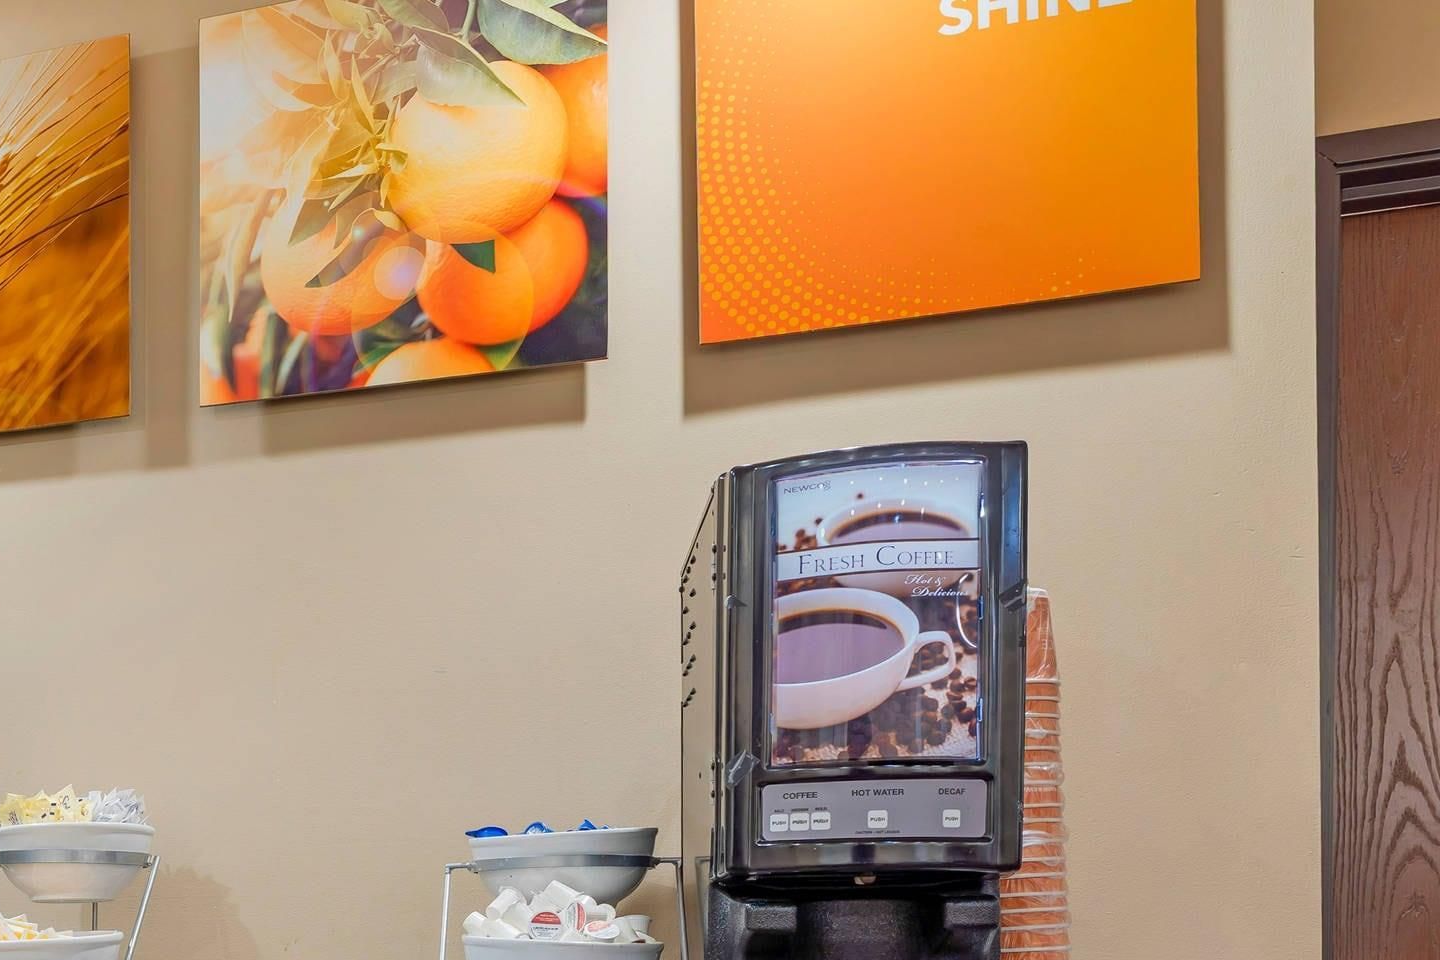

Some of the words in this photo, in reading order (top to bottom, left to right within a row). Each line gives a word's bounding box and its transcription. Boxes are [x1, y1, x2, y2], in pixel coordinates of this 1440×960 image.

[937, 0, 1133, 36] SHI
[904, 574, 932, 585] Hot
[911, 586, 968, 597] Delicious
[783, 792, 818, 800] COFFEE
[852, 789, 871, 797] HOT
[873, 788, 905, 796] WATER
